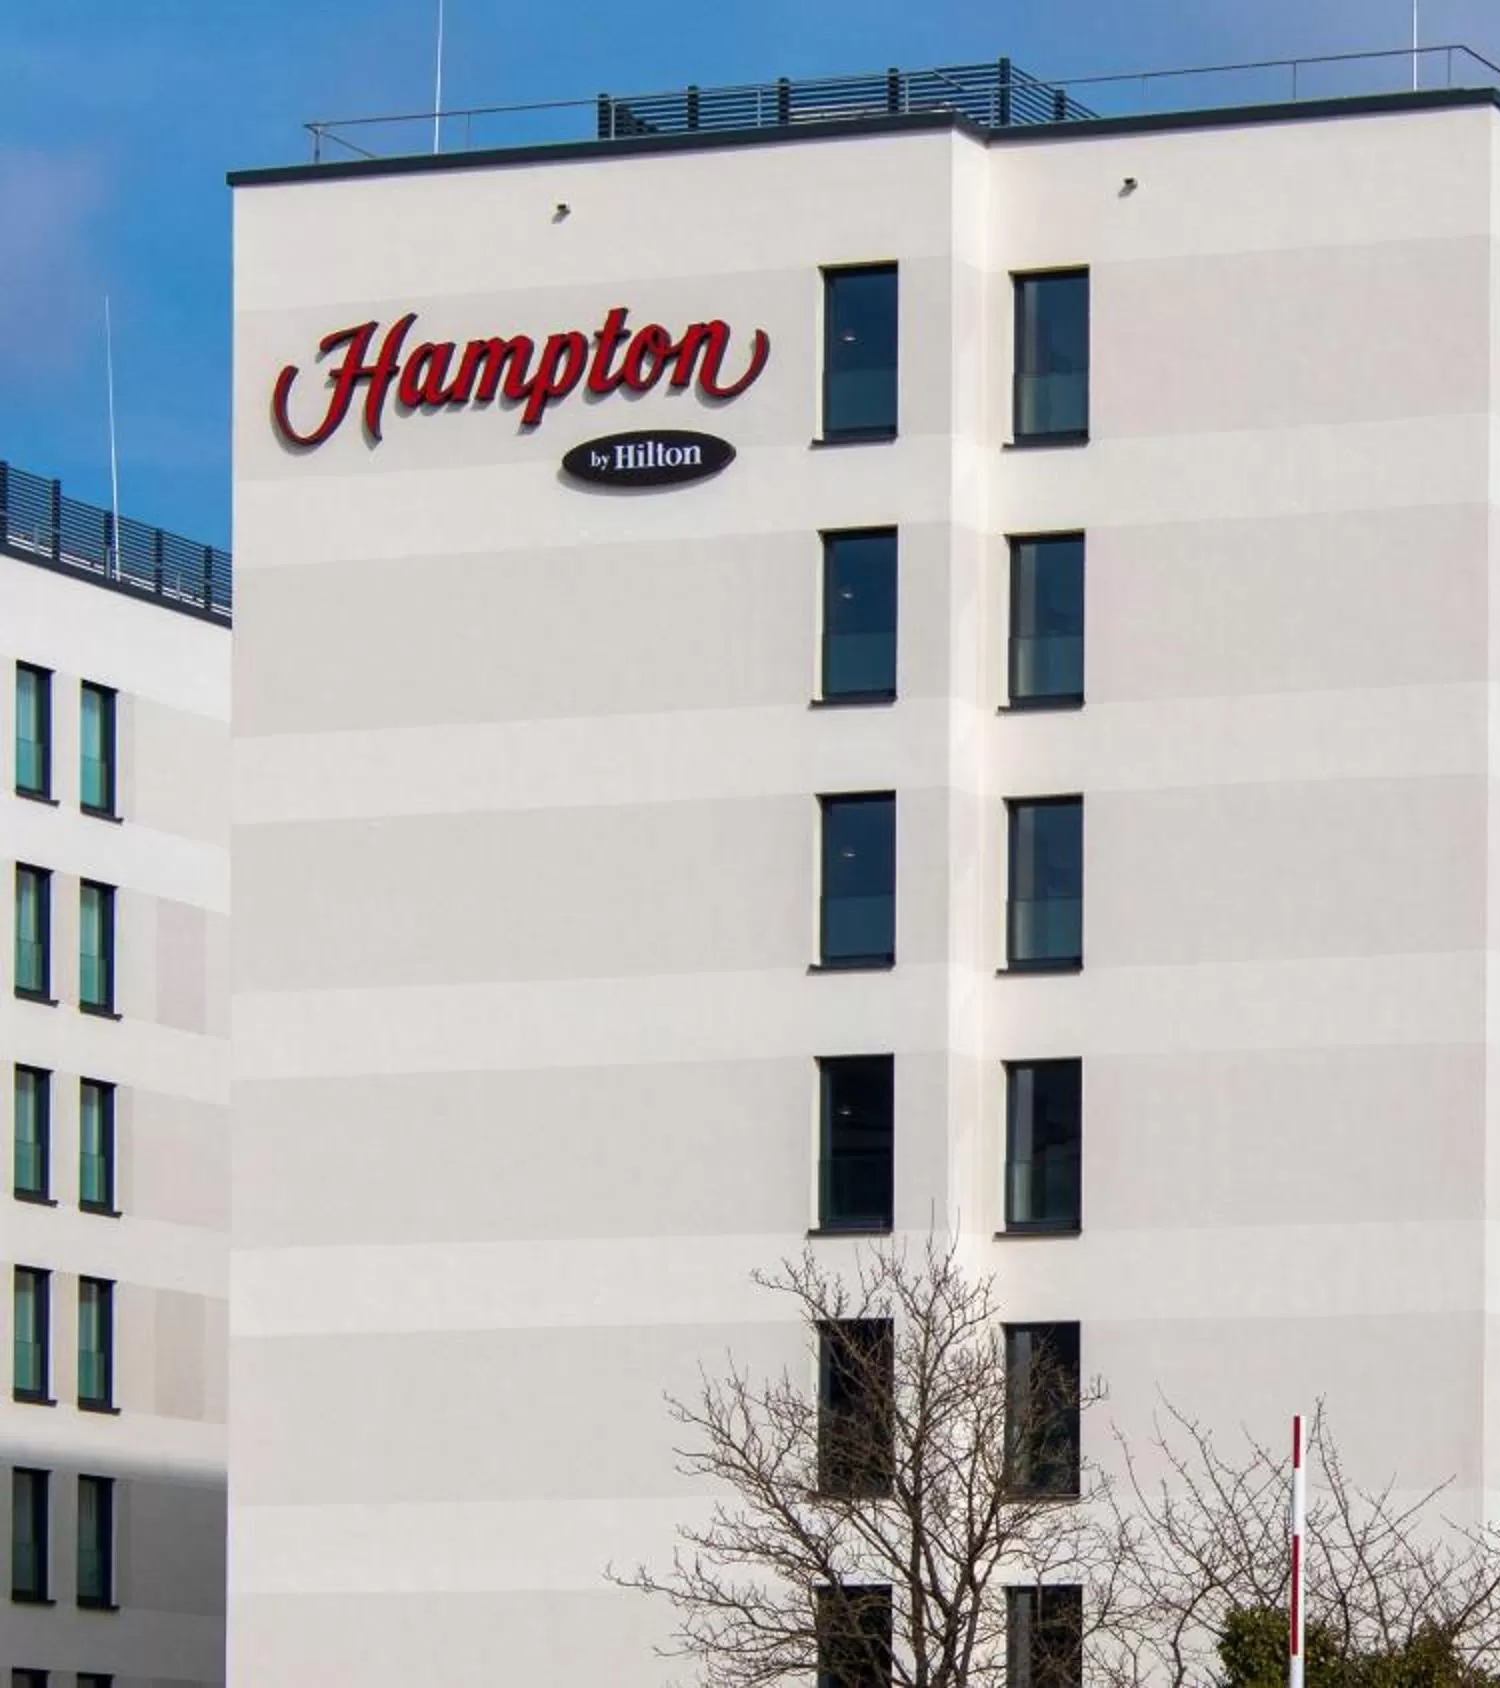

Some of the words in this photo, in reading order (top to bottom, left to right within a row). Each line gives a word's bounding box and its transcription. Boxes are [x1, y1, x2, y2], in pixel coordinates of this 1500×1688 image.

[274, 308, 770, 447] Hampton
[591, 451, 610, 471] by
[614, 441, 702, 470] Hilton
